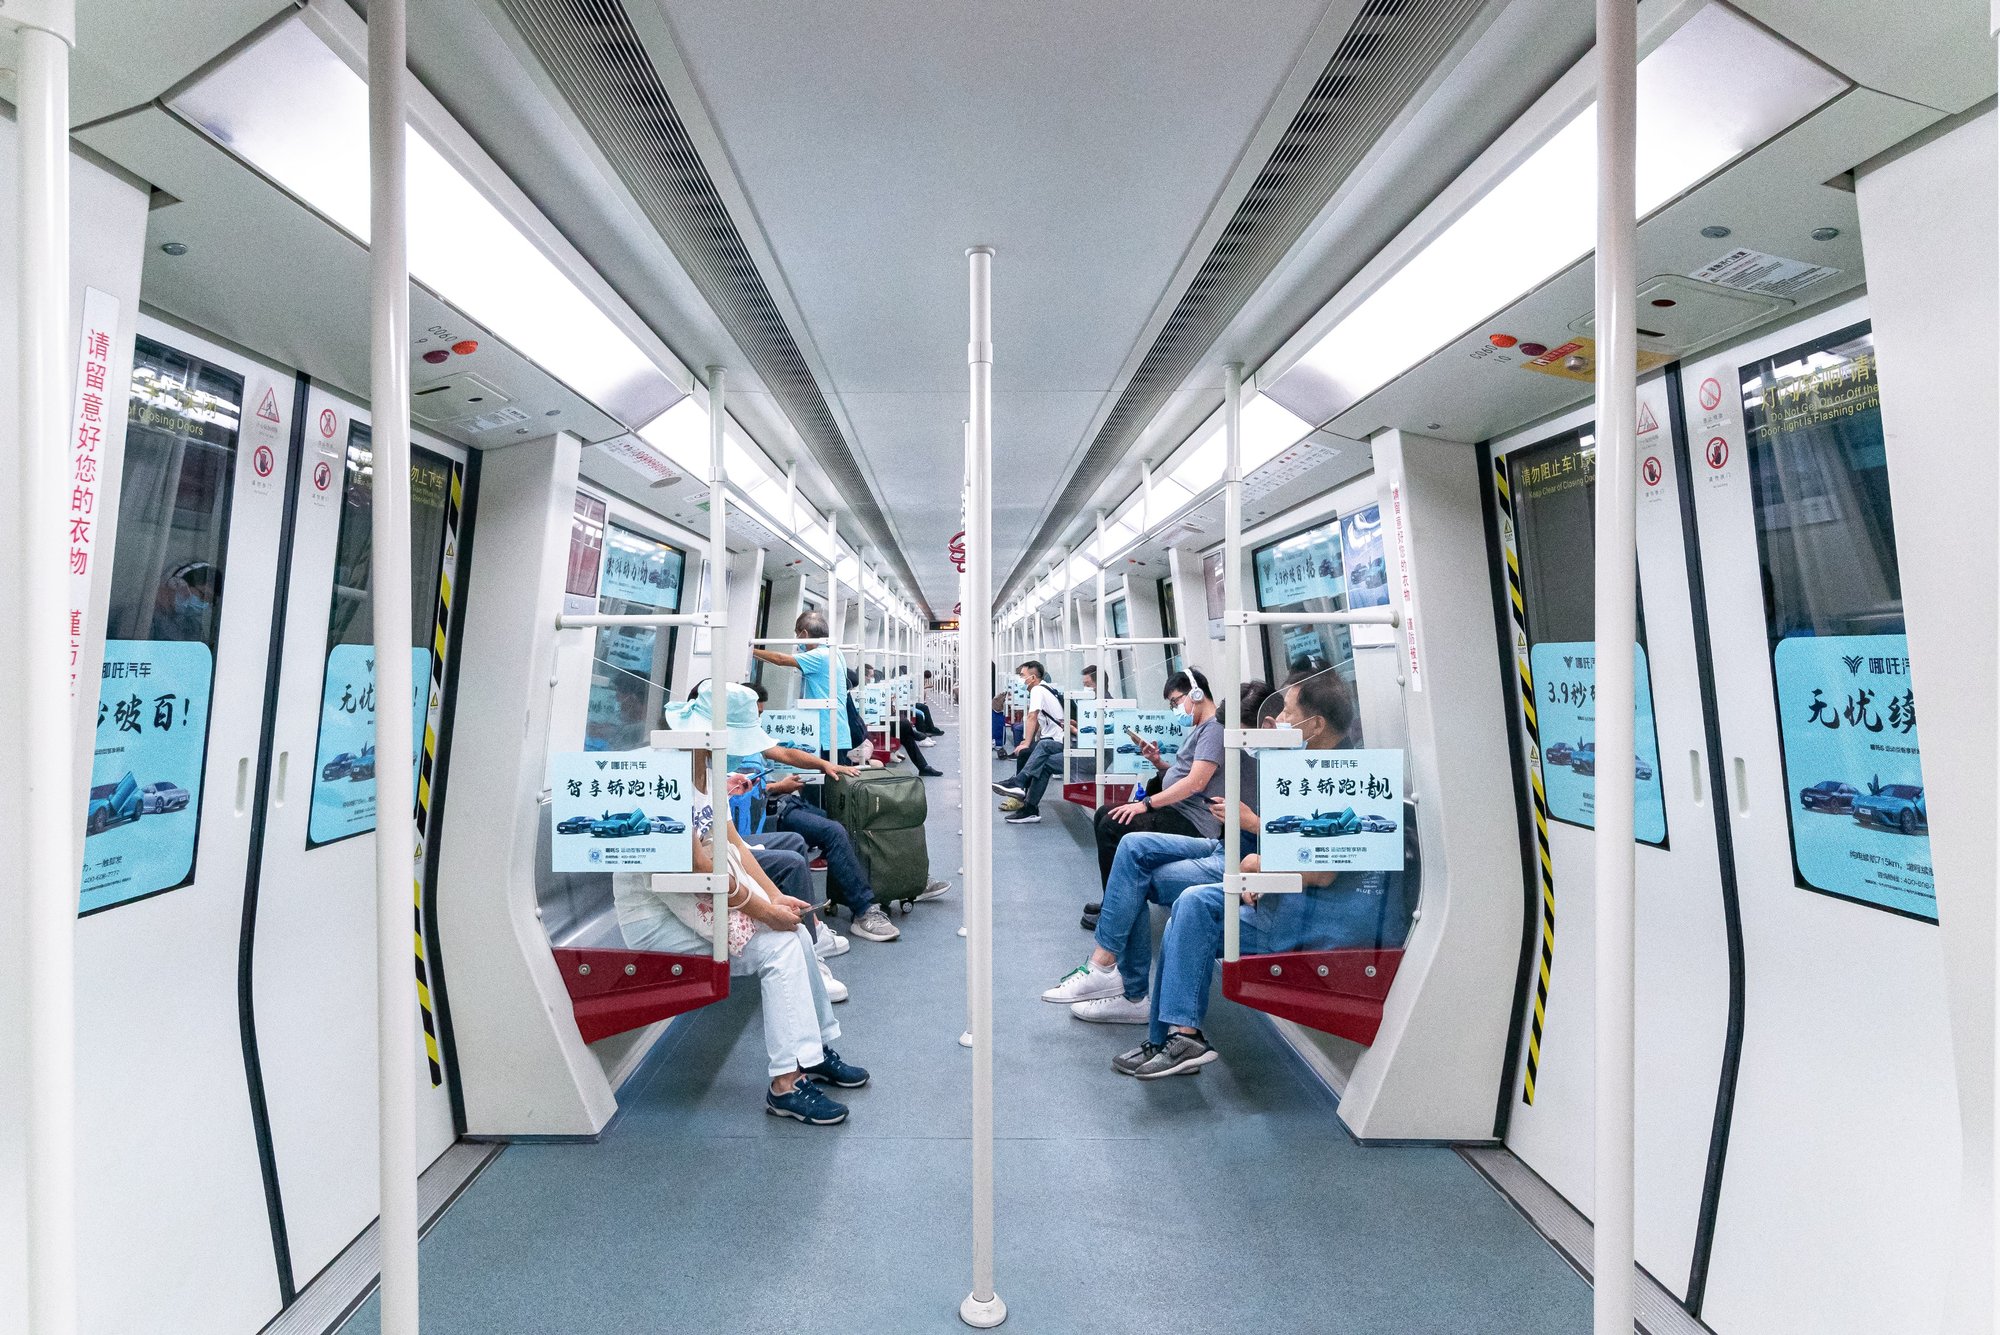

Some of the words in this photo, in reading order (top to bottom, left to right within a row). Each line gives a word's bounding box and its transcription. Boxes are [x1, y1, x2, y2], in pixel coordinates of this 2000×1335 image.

[1770, 411, 1782, 422] Do
[1784, 407, 1800, 418] Not
[1820, 397, 1833, 408] On
[1834, 393, 1845, 403] or
[1847, 387, 1861, 400] Off
[177, 418, 204, 436] Doors
[1761, 420, 1803, 438] Door-light
[1814, 405, 1854, 423] Flashing
[1856, 401, 1866, 412] or
[1868, 397, 1880, 407] th
[69, 328, 110, 576] 请留意好您的衣物
[1563, 478, 1584, 489] Closing
[762, 722, 815, 737] 享轿跑!靓
[610, 761, 648, 770] 哪吒汽车
[1321, 759, 1359, 769] 哪吒汽车
[566, 774, 681, 801] 智享轿跑!靓
[1275, 773, 1393, 800] 智享轿跑!靓
